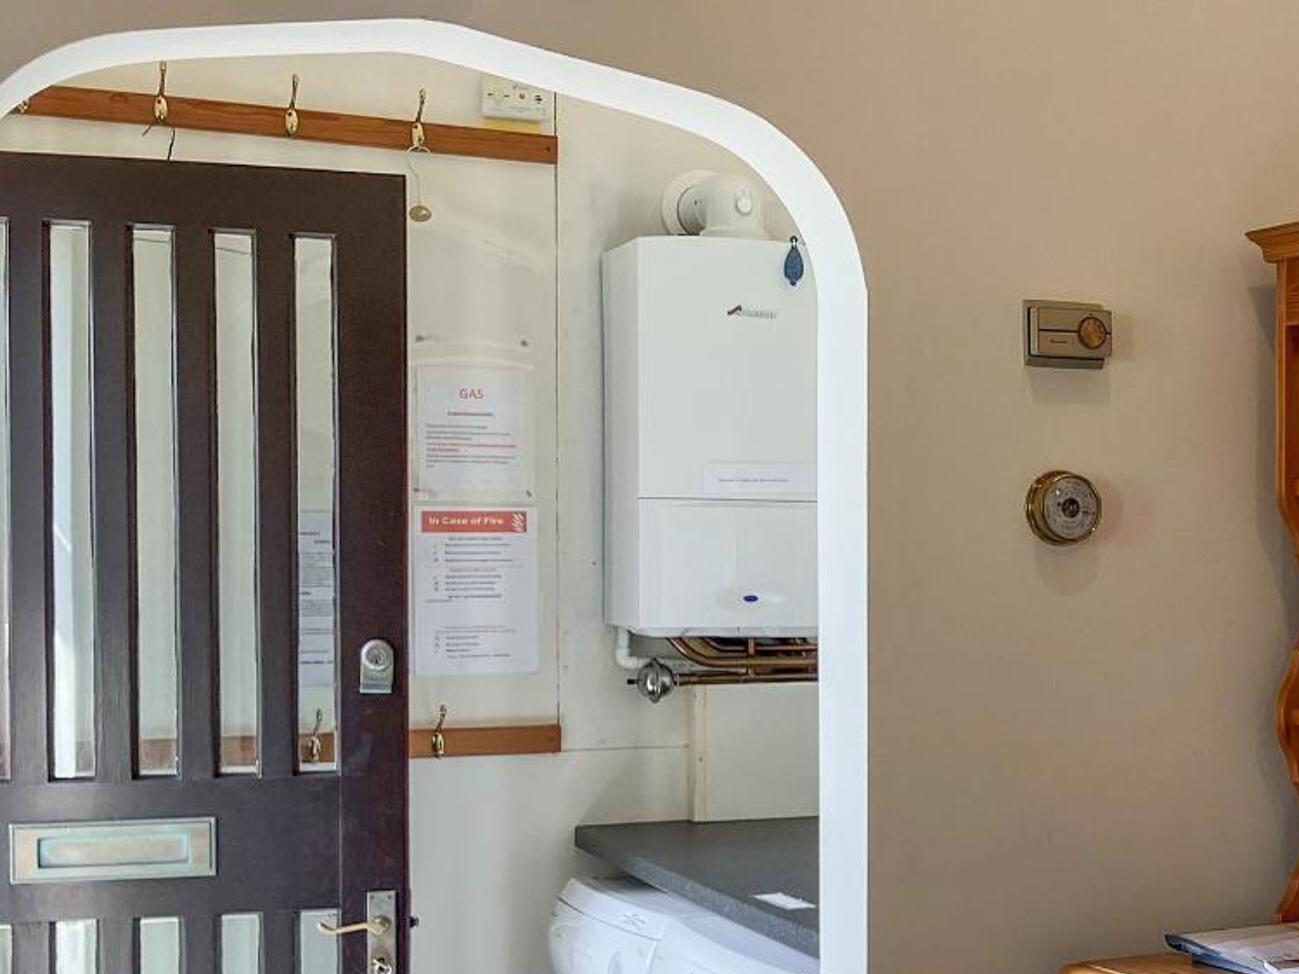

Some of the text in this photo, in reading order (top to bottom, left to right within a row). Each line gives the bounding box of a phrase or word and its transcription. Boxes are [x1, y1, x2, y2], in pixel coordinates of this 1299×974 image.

[459, 388, 485, 400] GAS
[428, 515, 504, 525] In Case of Fire
